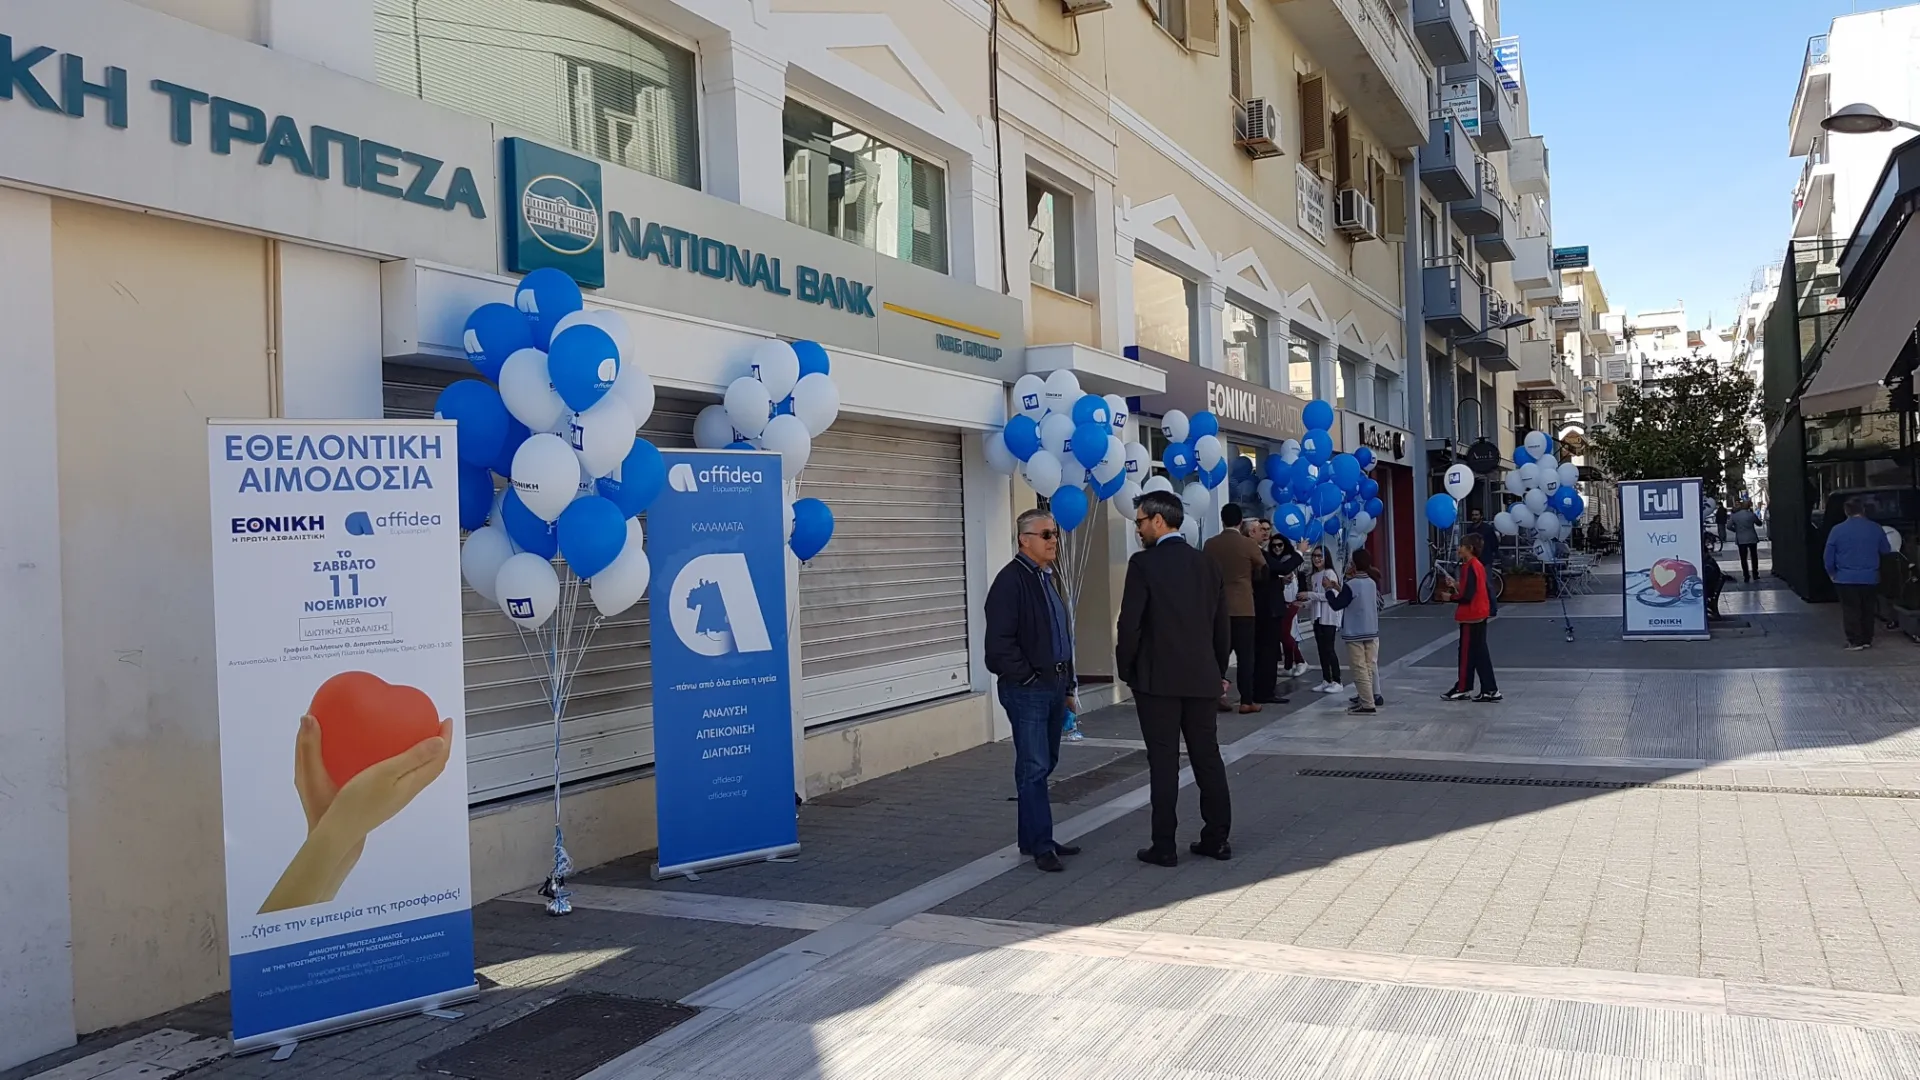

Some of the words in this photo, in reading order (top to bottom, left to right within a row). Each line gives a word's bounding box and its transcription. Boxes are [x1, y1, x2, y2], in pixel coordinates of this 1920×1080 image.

[151, 79, 486, 219] ΤΡΑΠΕΖΑ
[608, 210, 791, 296] NATIONAL
[796, 265, 876, 318] BANK
[963, 340, 1003, 362] GROUP
[225, 434, 443, 461] ΕΘΕΛΟΝΤΙΚΗ
[238, 465, 433, 493] ΑΙΜΟΔΟΣΙΑ
[698, 465, 763, 483] affidea
[1643, 487, 1679, 512] Full
[376, 511, 441, 527] affidea
[691, 521, 745, 533] ΚΑΛΑΜΑΤΑ
[240, 535, 268, 543] ΠΡΩΤΗ
[270, 533, 325, 542] ΑΣΦΑΛΙΣΤΙΚΗ
[336, 550, 352, 558] το
[313, 558, 376, 572] ΣΑΒΒΑΤΟ
[329, 573, 359, 597] 11
[304, 596, 387, 612] ΝΟΕΜΒΡΙΟΥ
[509, 601, 531, 615] Full
[333, 617, 361, 626] ΗΜΕΡΑ
[304, 627, 342, 637] ΙΔΙΩΤΙΚΗΣ
[344, 623, 389, 634] ΑΣΦΑΛΙΣΗΣ
[702, 705, 748, 719] ΑΝΑΛΥΣΗ
[696, 723, 755, 740] ΑΠΕΙΚΟΝΙΣΗ
[702, 744, 751, 759] ΔΙΑΓΝΩΣΗ
[285, 919, 306, 931] την
[310, 906, 363, 927] εμπειρία
[366, 903, 387, 915] της
[389, 887, 460, 911] προσφοράς!
